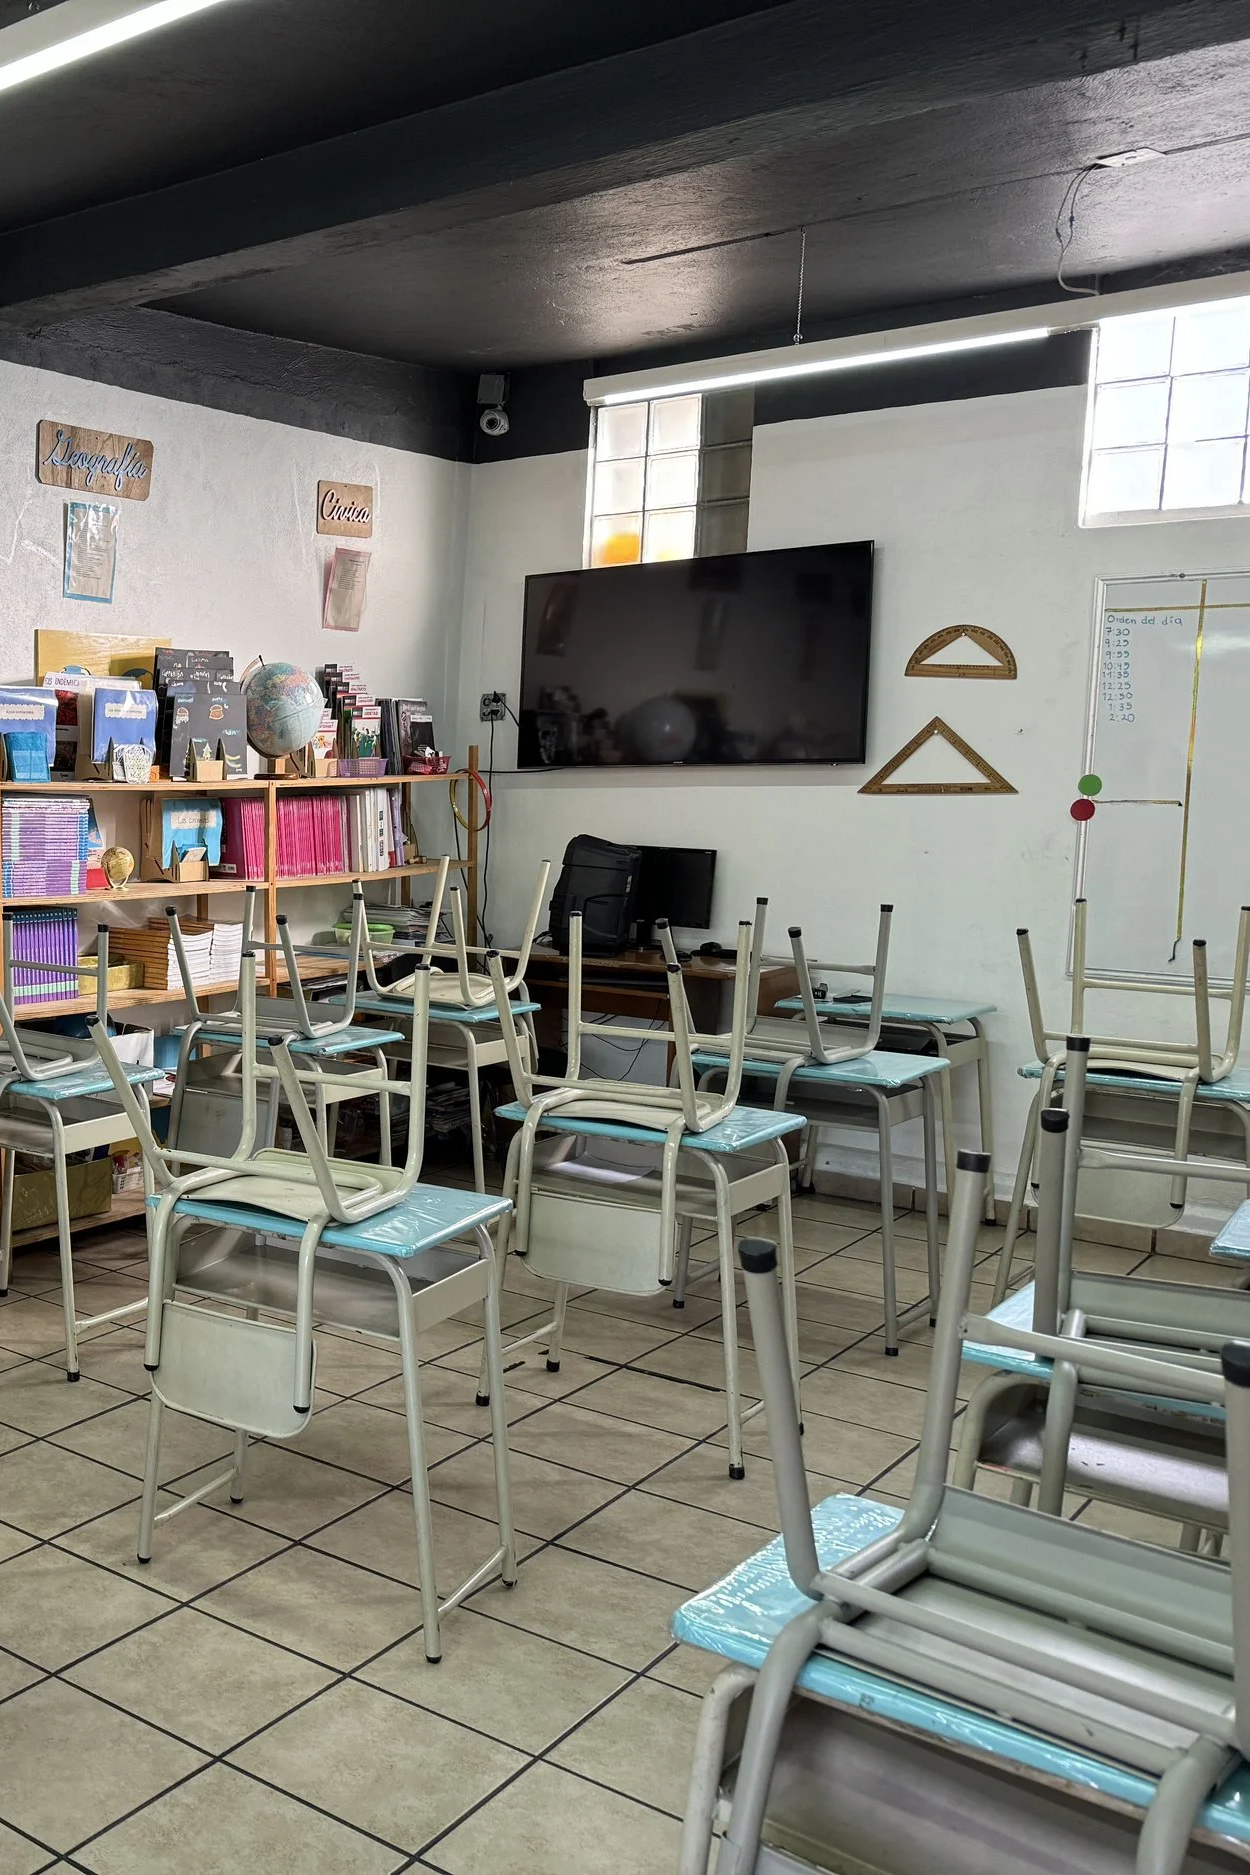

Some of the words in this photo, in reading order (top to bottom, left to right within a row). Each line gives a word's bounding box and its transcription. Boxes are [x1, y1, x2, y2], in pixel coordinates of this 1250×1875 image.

[1107, 614, 1137, 625] Orden
[1141, 615, 1155, 625] del
[1105, 628, 1130, 637] 7:30
[1105, 638, 1129, 648] 9:25
[1105, 650, 1130, 659] 9:55
[1103, 662, 1130, 671] 10:45
[1102, 671, 1130, 679] 11:35
[1102, 682, 1131, 690] 12:25
[1102, 692, 1133, 701] 12:50
[1109, 703, 1133, 711] 1:35
[1109, 713, 1135, 723] 2:20
